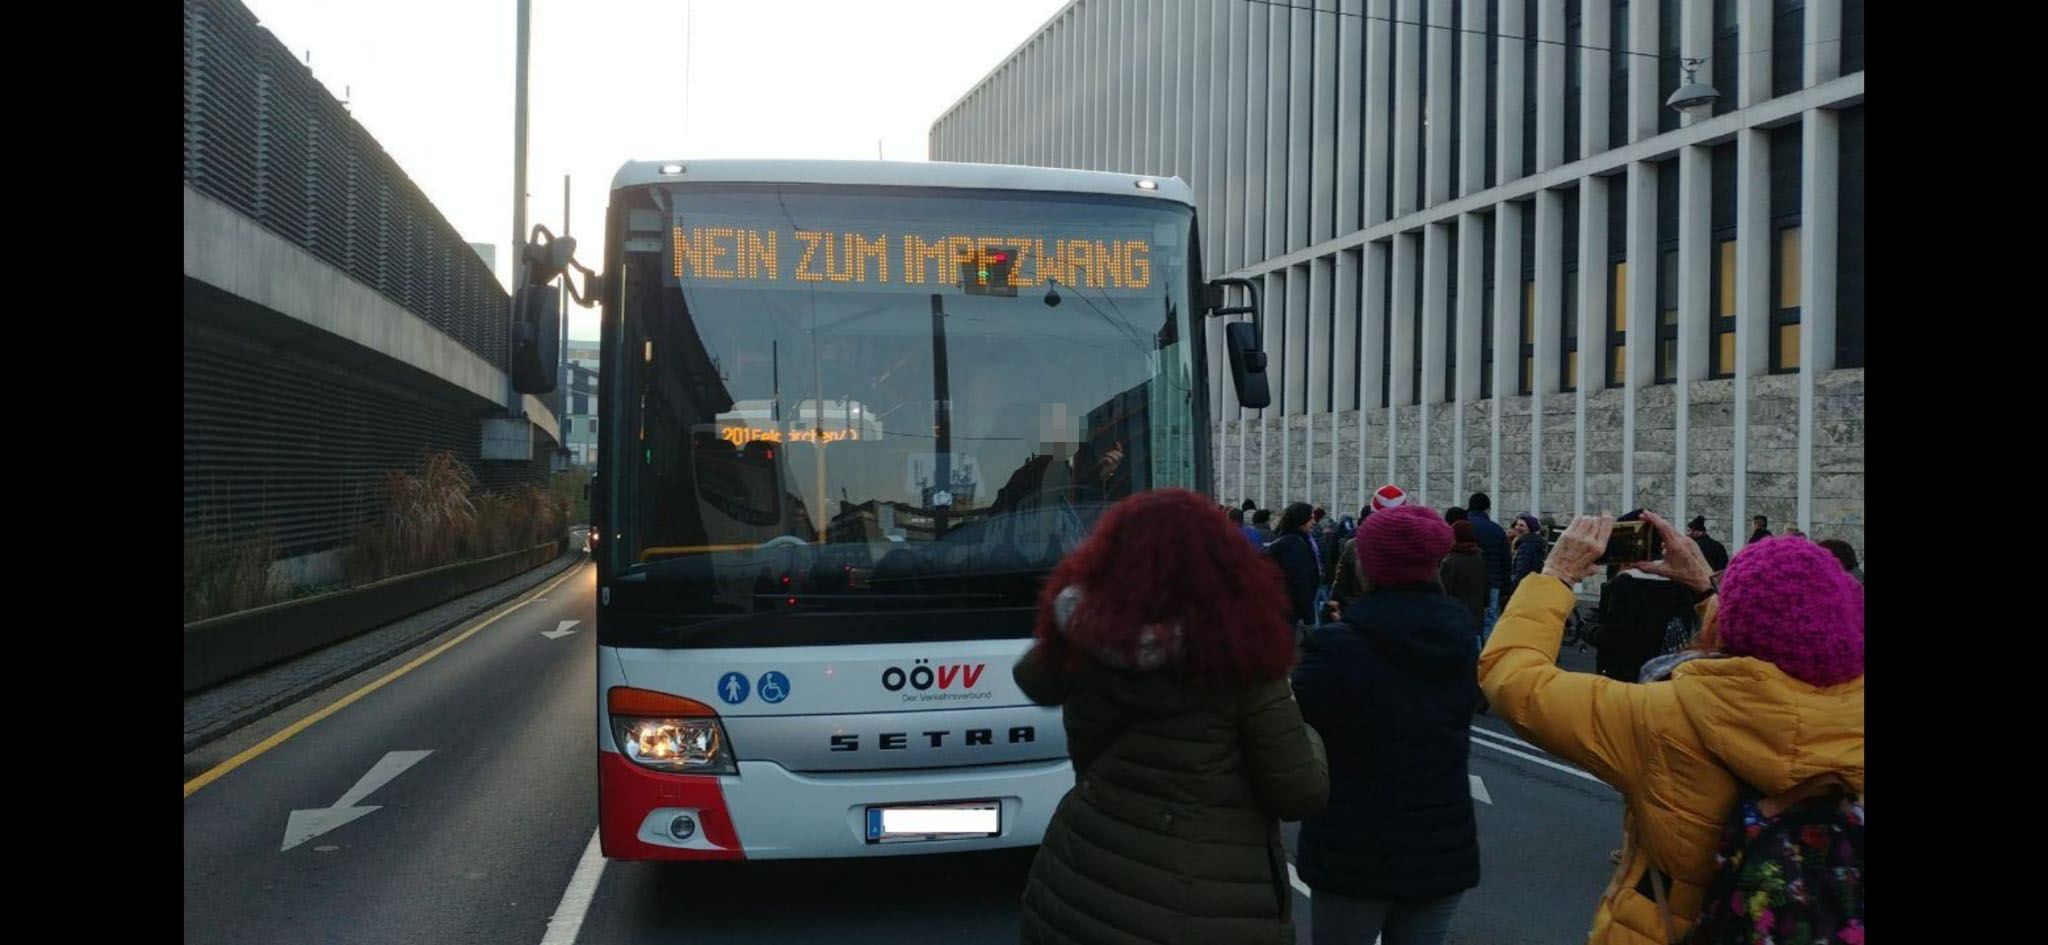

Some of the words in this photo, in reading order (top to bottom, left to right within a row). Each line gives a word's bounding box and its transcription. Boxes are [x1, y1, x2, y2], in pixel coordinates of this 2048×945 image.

[673, 226, 777, 280] NEIN
[795, 230, 889, 283] ZUM
[904, 234, 1151, 289] IMPFZWANG
[881, 658, 986, 691] OÖVV
[902, 693, 918, 702] Der
[920, 690, 992, 702] Verkehrsverbund
[830, 726, 1036, 752] SETRA
